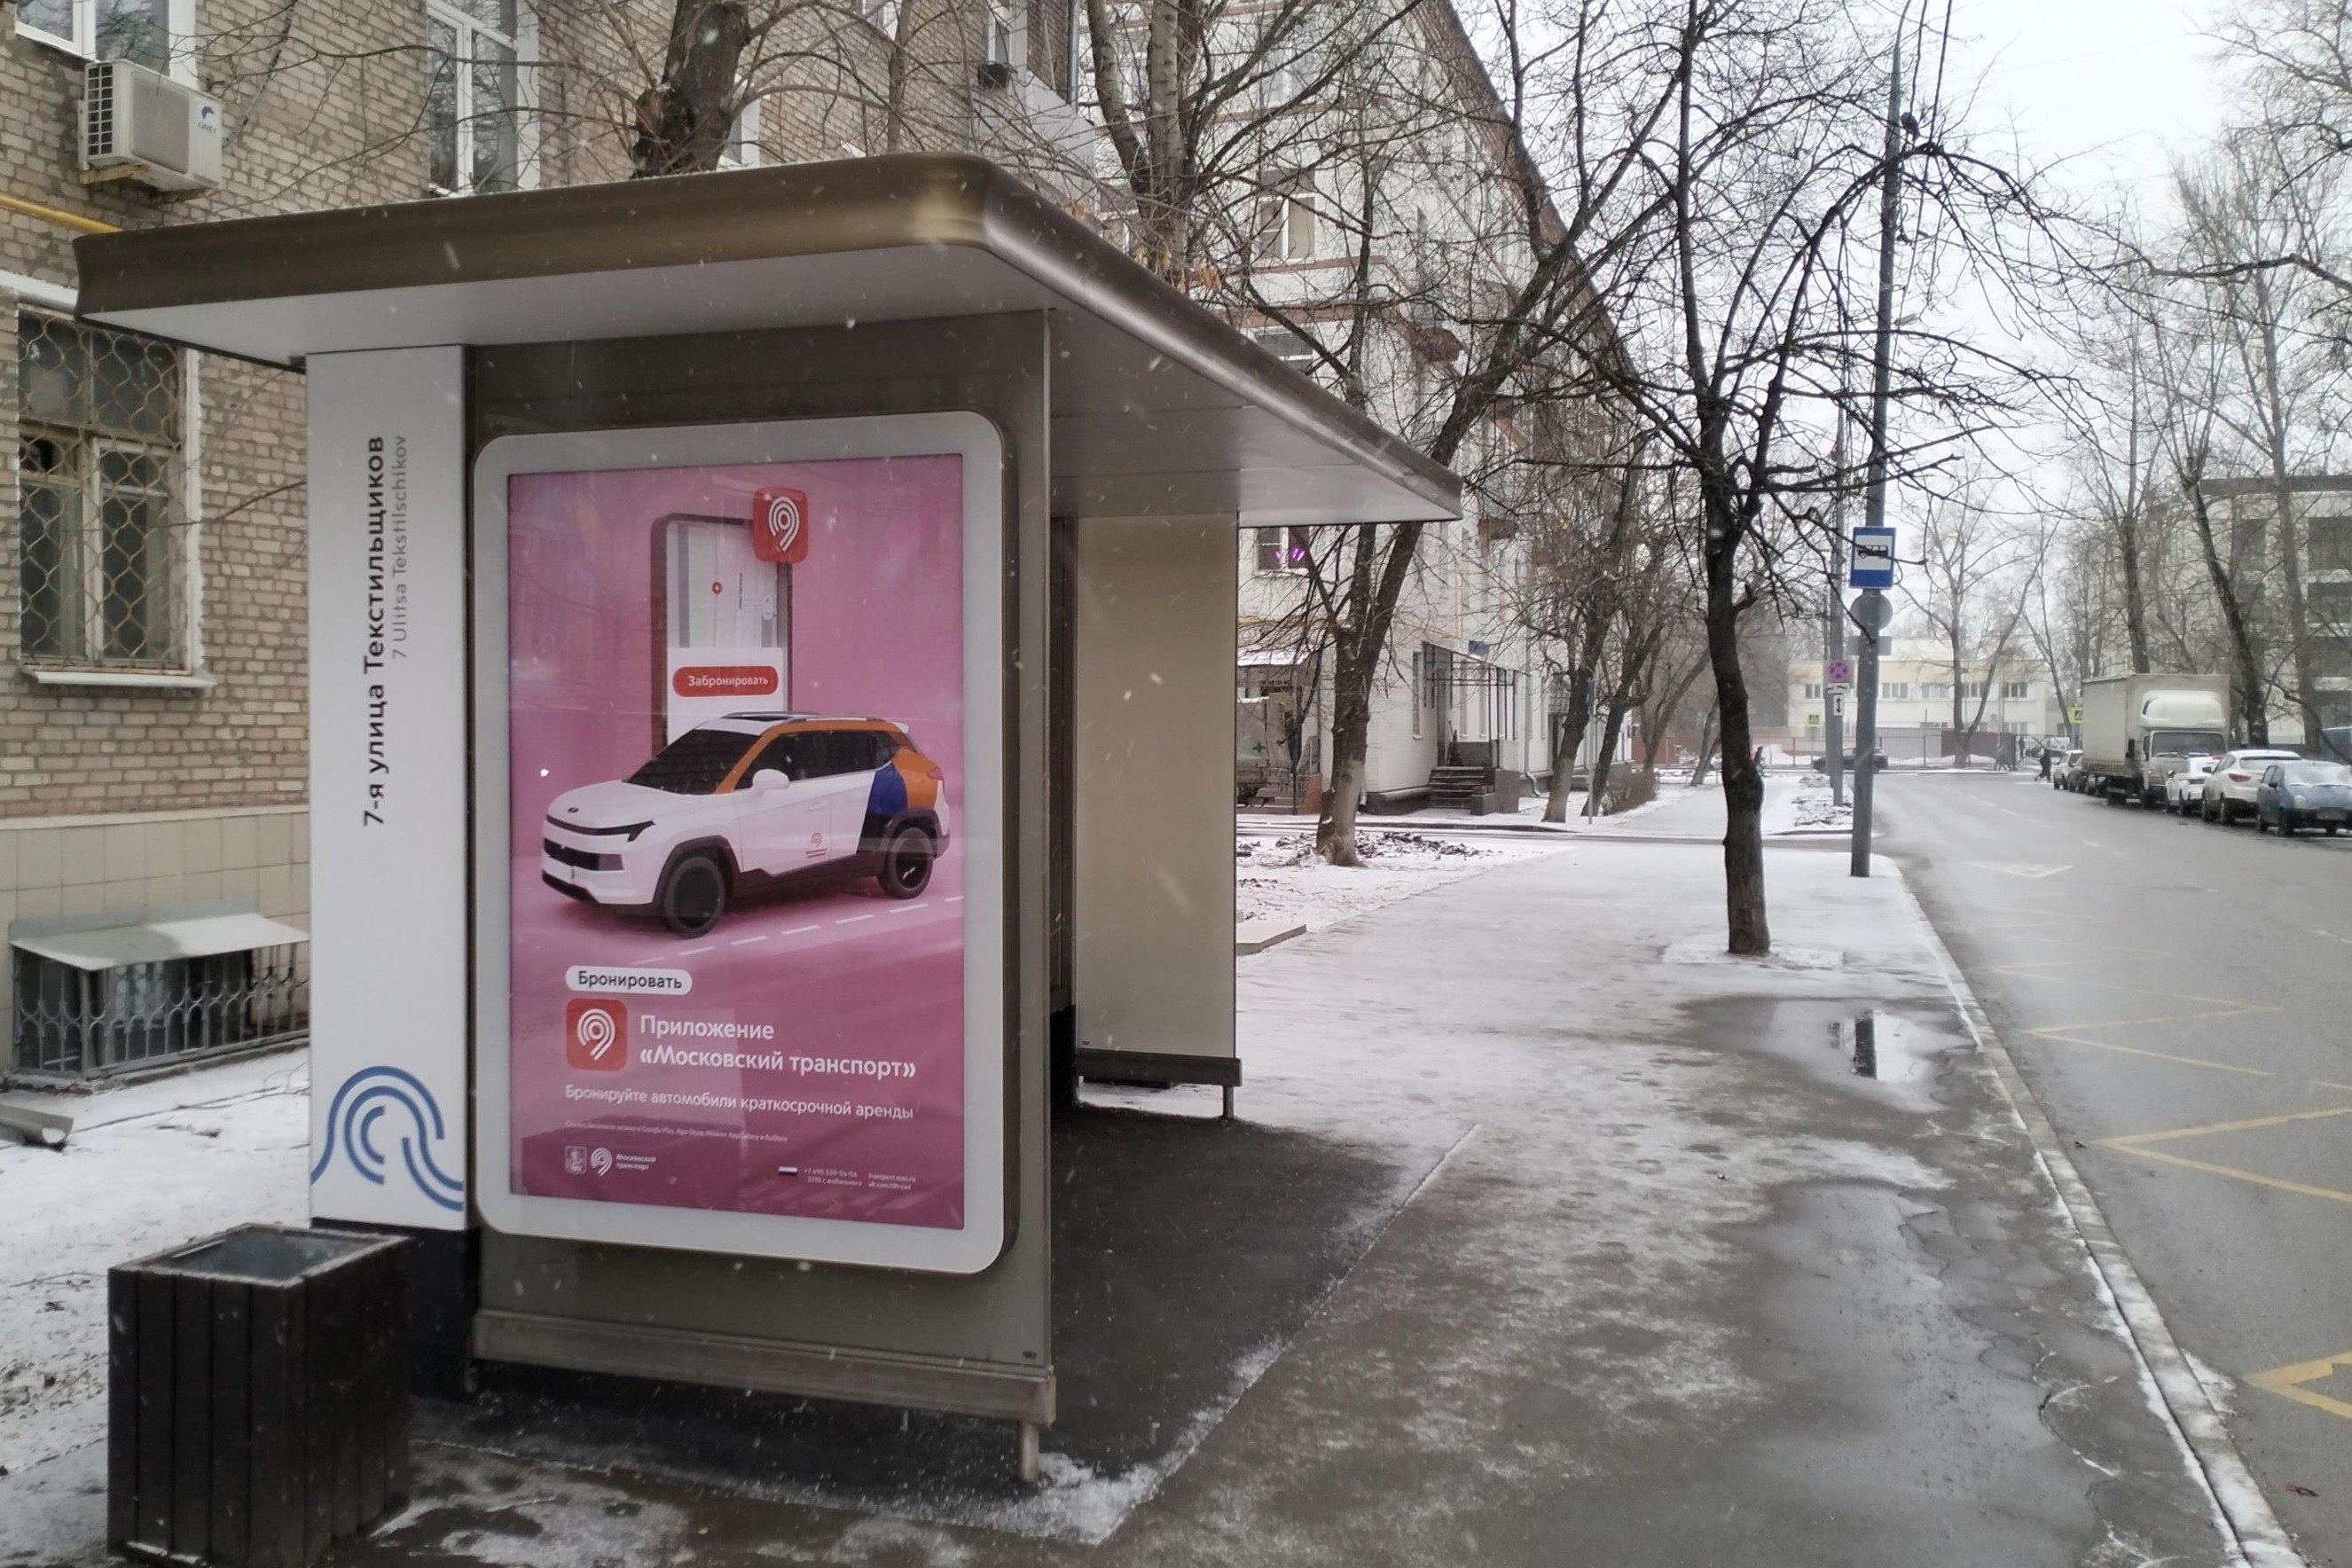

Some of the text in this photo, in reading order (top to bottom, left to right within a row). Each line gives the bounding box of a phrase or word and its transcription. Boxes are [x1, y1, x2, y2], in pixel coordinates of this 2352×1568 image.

[392, 435, 407, 660] 7 Ulitsa Tekstilschikov
[363, 436, 389, 827] 7-я улица Текстильщиков
[687, 674, 769, 688] Забронировать
[578, 970, 683, 990] Бронировать
[640, 1015, 775, 1039] Приложение
[639, 1045, 916, 1080] «Московский транспорт»
[565, 1084, 913, 1120] Бронируйте автомобили краткосрочной аренды
